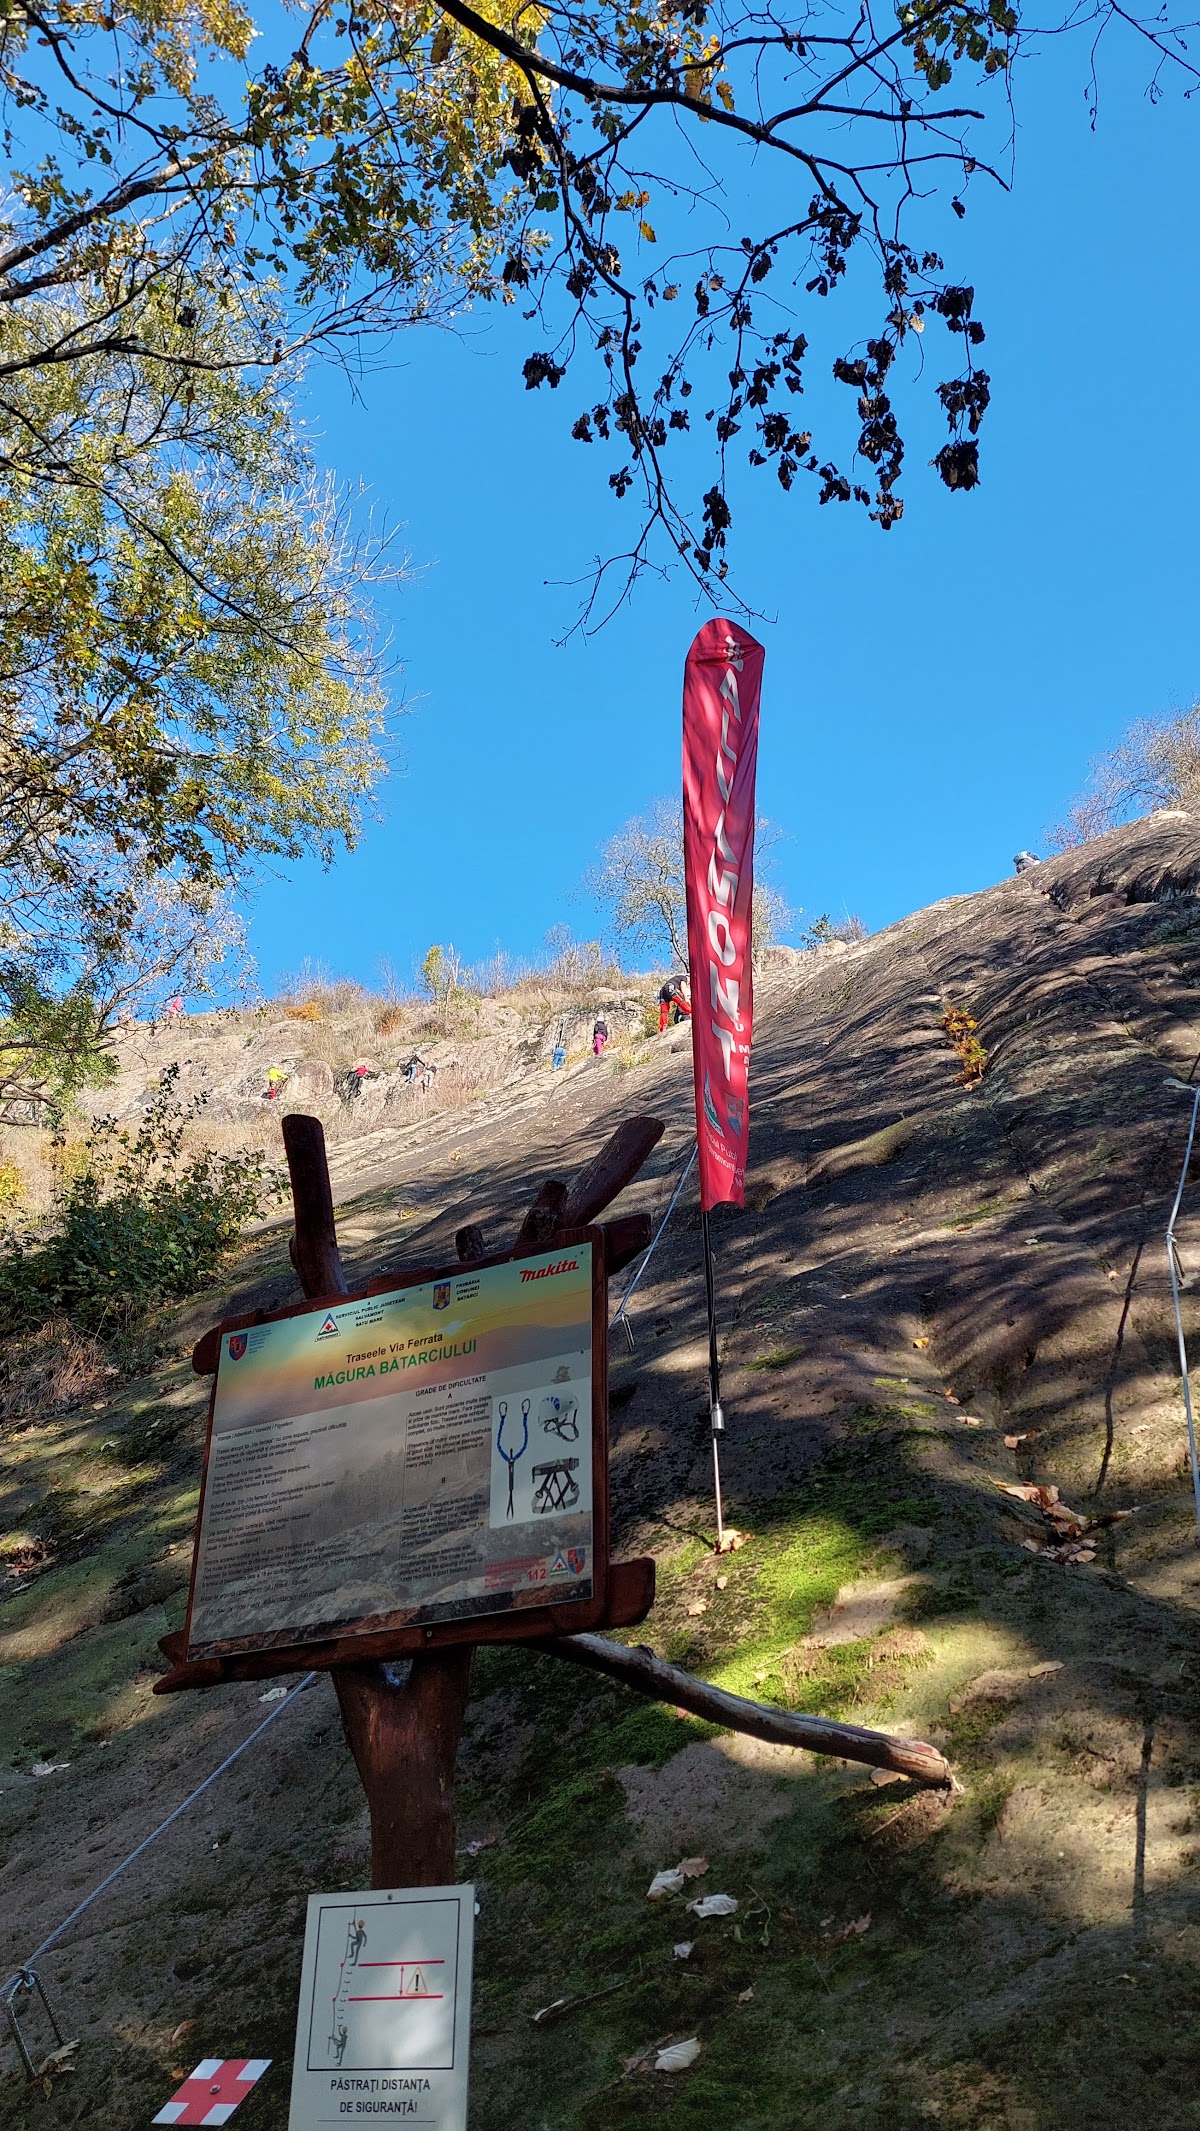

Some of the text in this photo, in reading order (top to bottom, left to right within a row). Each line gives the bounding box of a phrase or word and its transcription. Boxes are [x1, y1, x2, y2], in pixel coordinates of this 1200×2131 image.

[456, 1285, 480, 1296] COMUNEI
[335, 1308, 360, 1320] SERVICIUL
[361, 1304, 379, 1314] PUBLIC
[355, 1309, 385, 1321] SALVAMONT
[355, 1316, 383, 1328] SATU MARE
[346, 1333, 443, 1364] Traseele Via Ferrata
[314, 1339, 477, 1390] MĂGURA BĂTARCIULUI
[415, 1375, 487, 1397] GRADE DE DIFICULTATE
[527, 1568, 546, 1581] 112
[340, 2101, 353, 2113] DE
